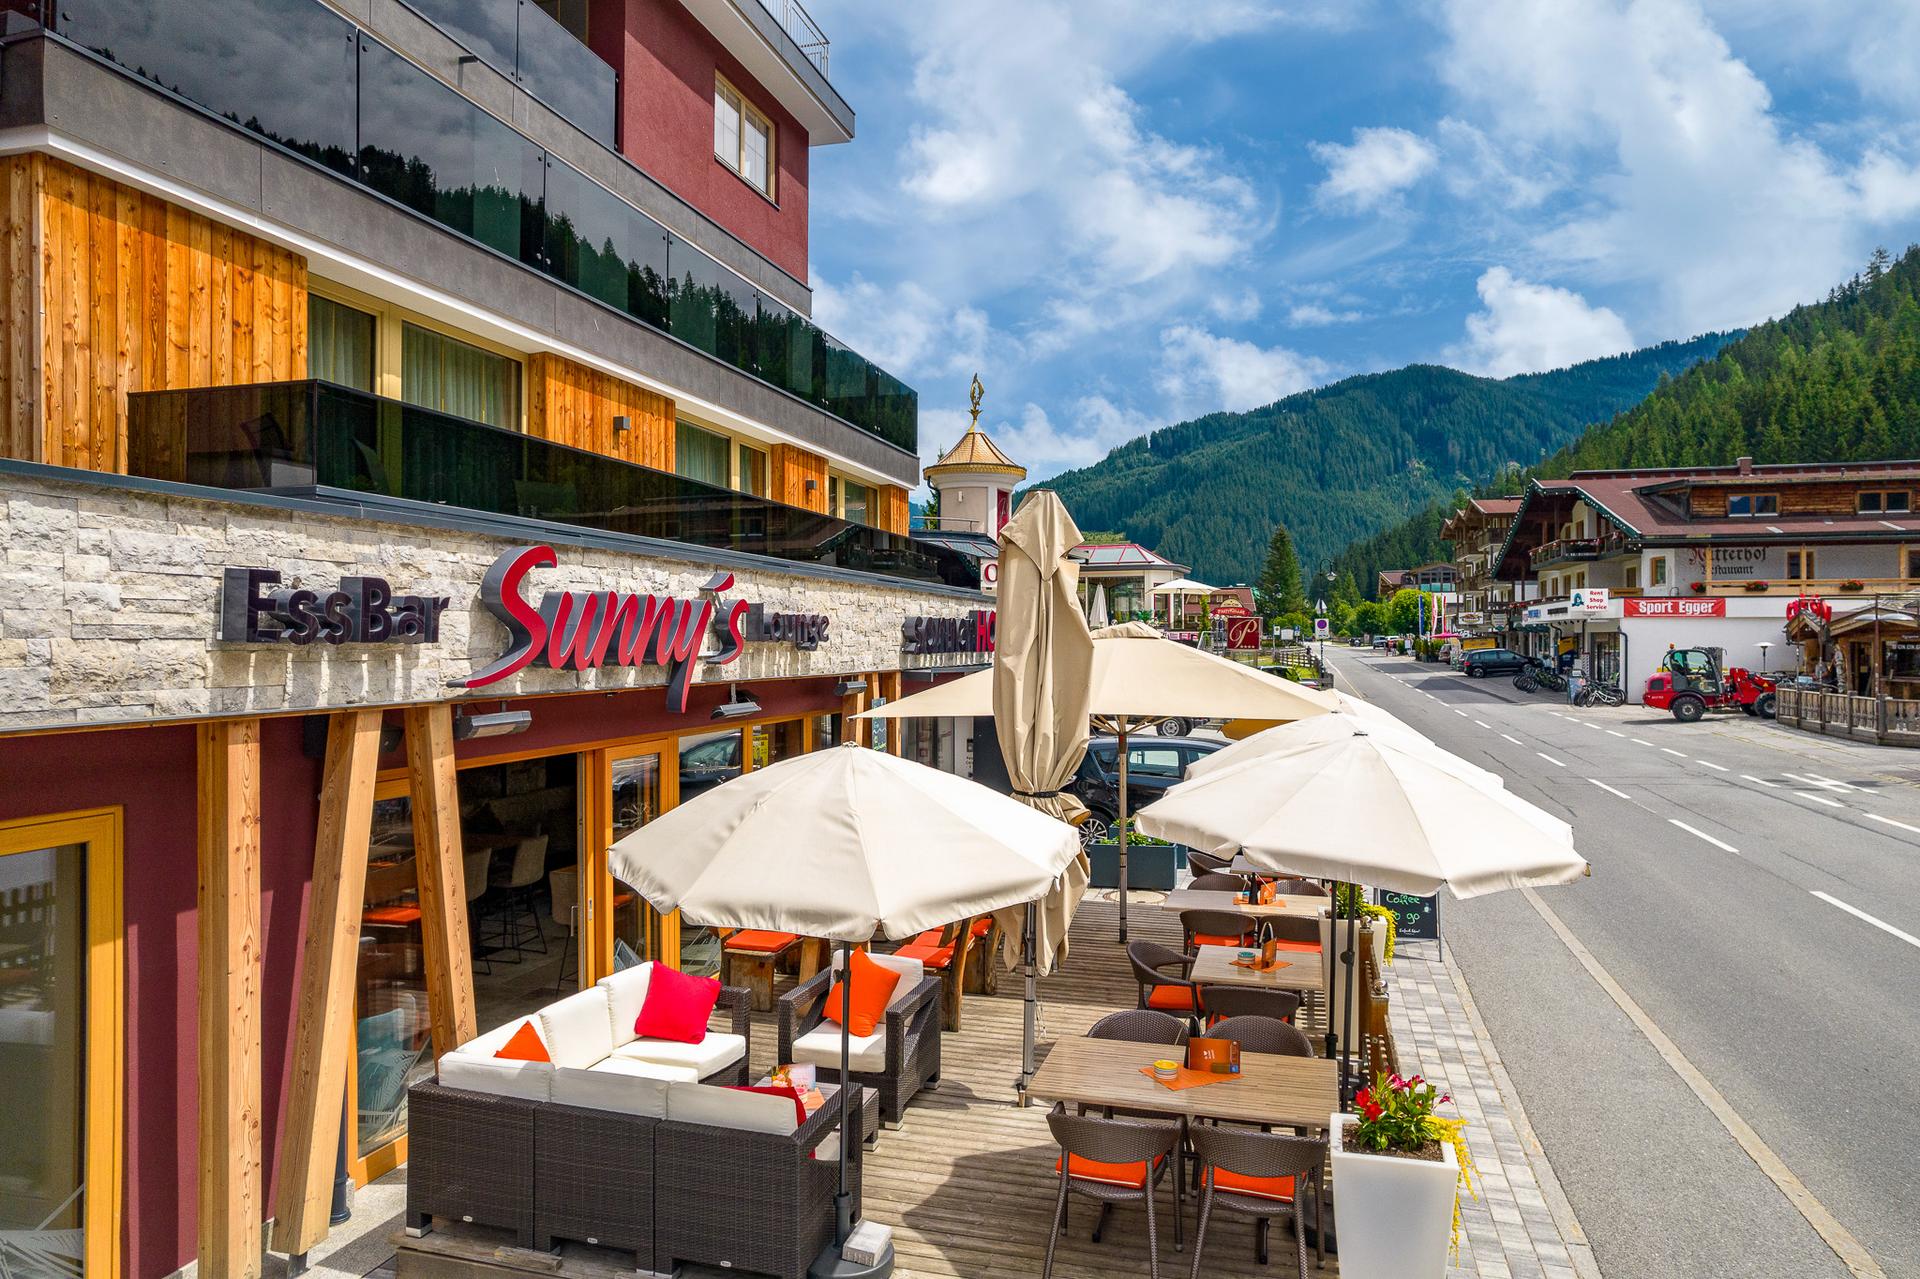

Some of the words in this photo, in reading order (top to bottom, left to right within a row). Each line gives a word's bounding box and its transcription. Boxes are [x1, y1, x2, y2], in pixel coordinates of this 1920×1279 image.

[222, 567, 450, 645] EssBar
[1639, 601, 1673, 614] Sport
[1679, 601, 1714, 615] Egger
[446, 545, 750, 713] Sunny's
[745, 602, 830, 651] Lounge
[1386, 893, 1420, 905] Coffee
[1406, 913, 1420, 925] go
